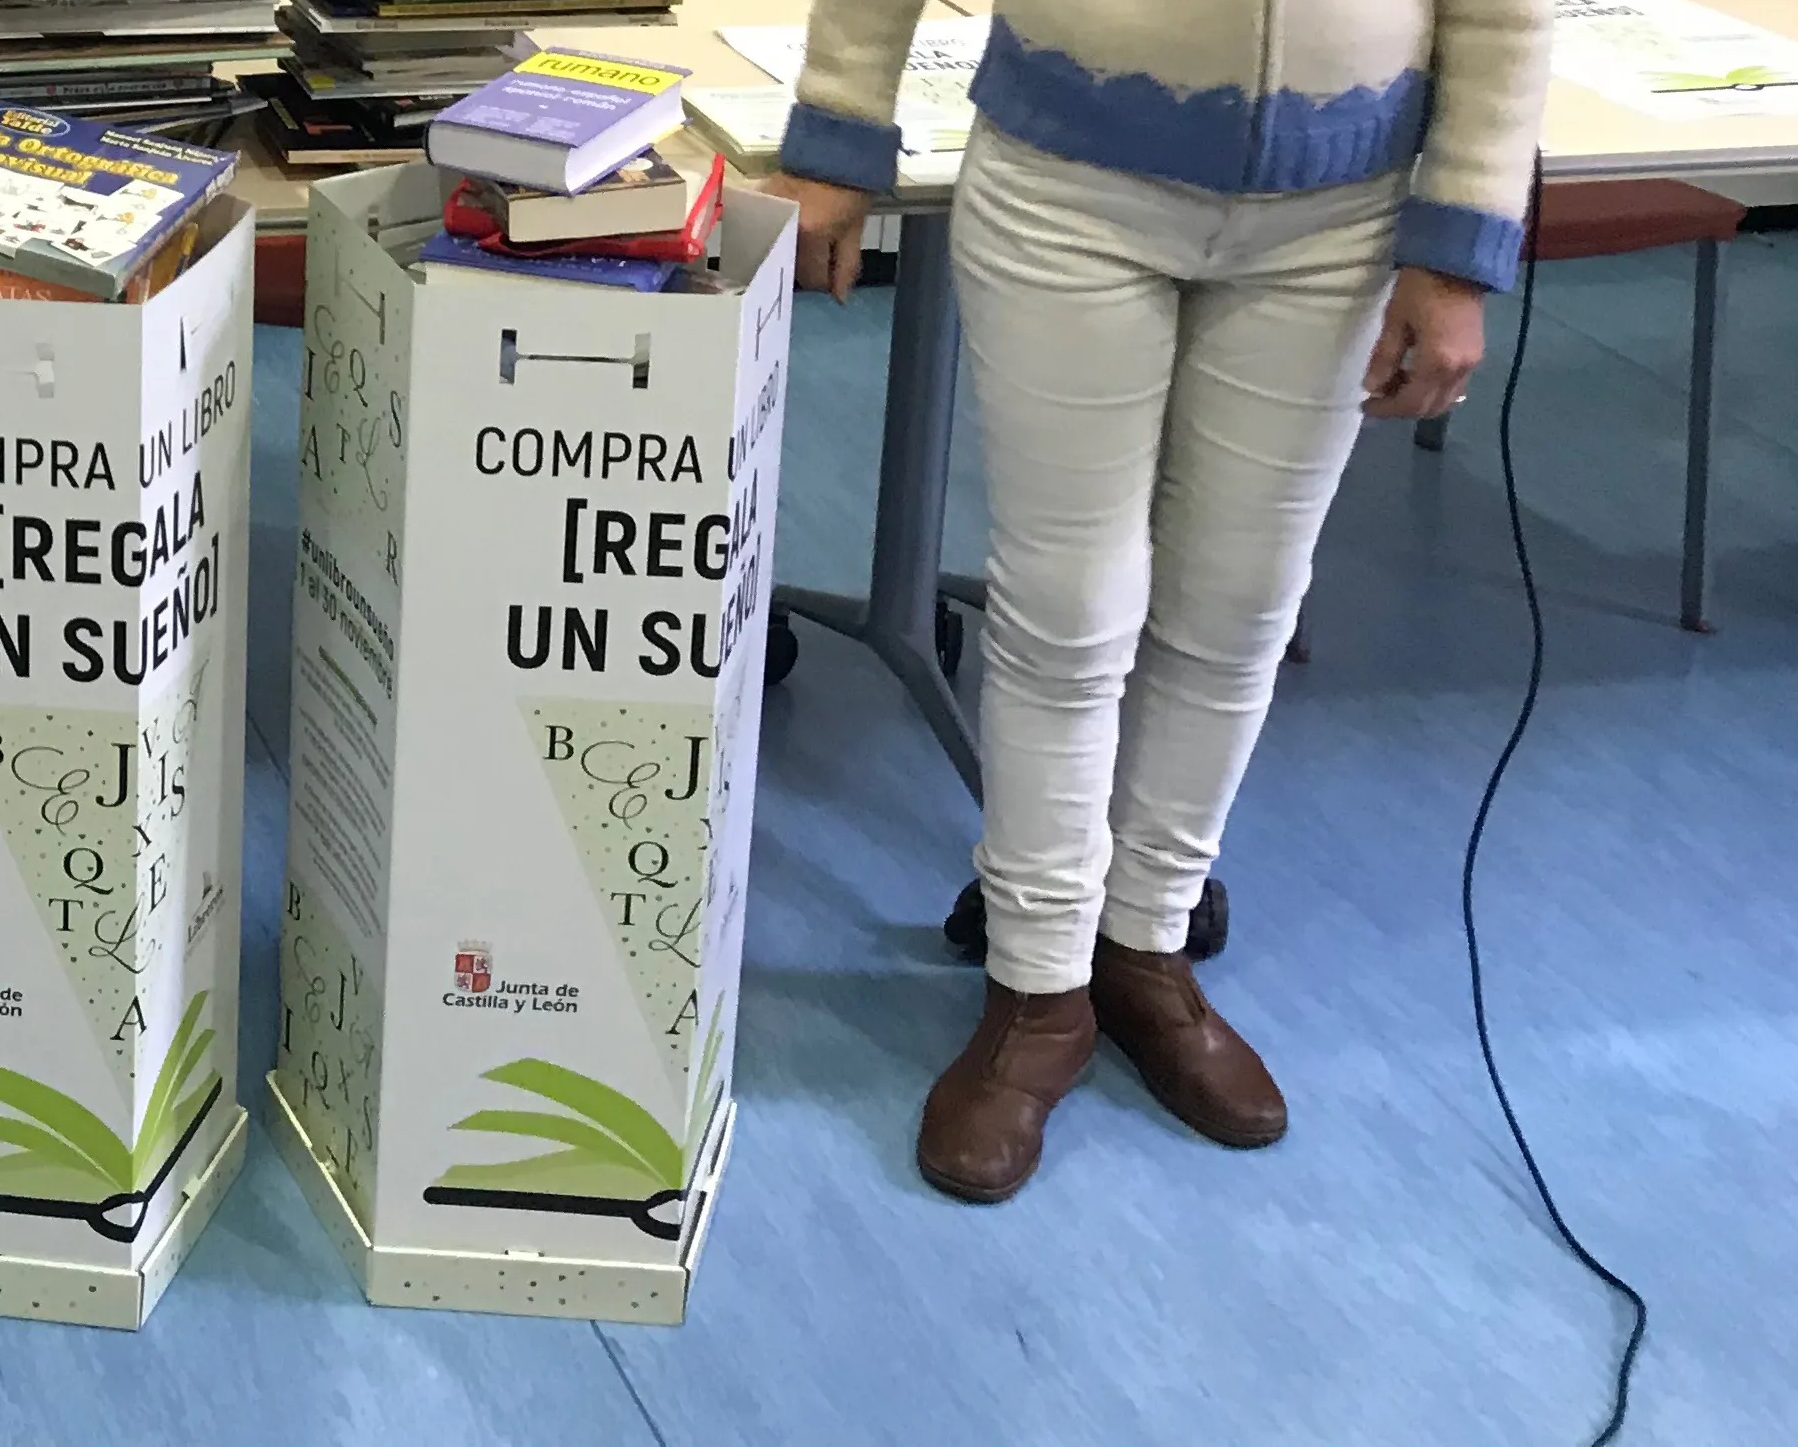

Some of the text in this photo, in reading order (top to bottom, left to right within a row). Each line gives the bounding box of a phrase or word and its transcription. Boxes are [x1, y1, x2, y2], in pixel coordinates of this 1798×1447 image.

[537, 56, 661, 88] rumano
[17, 136, 180, 185] Ortográfica
[139, 420, 173, 489] UN
[181, 359, 237, 456] LIBRO
[475, 425, 704, 484] COMPRA
[727, 416, 749, 482] UN
[563, 467, 759, 584] [REGALA
[61, 531, 220, 687] SUEÑO]
[319, 582, 338, 622] 30
[506, 532, 761, 680] UN SUEÑO]
[543, 724, 576, 762] B
[95, 742, 137, 808] J
[665, 735, 709, 802] J
[63, 847, 114, 895] Q
[627, 840, 679, 889] Q
[48, 897, 84, 933] T
[610, 891, 647, 926] T
[0, 986, 24, 1003] de
[442, 992, 579, 1014] Castilla y León
[495, 979, 580, 998] Junta de
[665, 987, 701, 1036] A
[110, 994, 148, 1042] A
